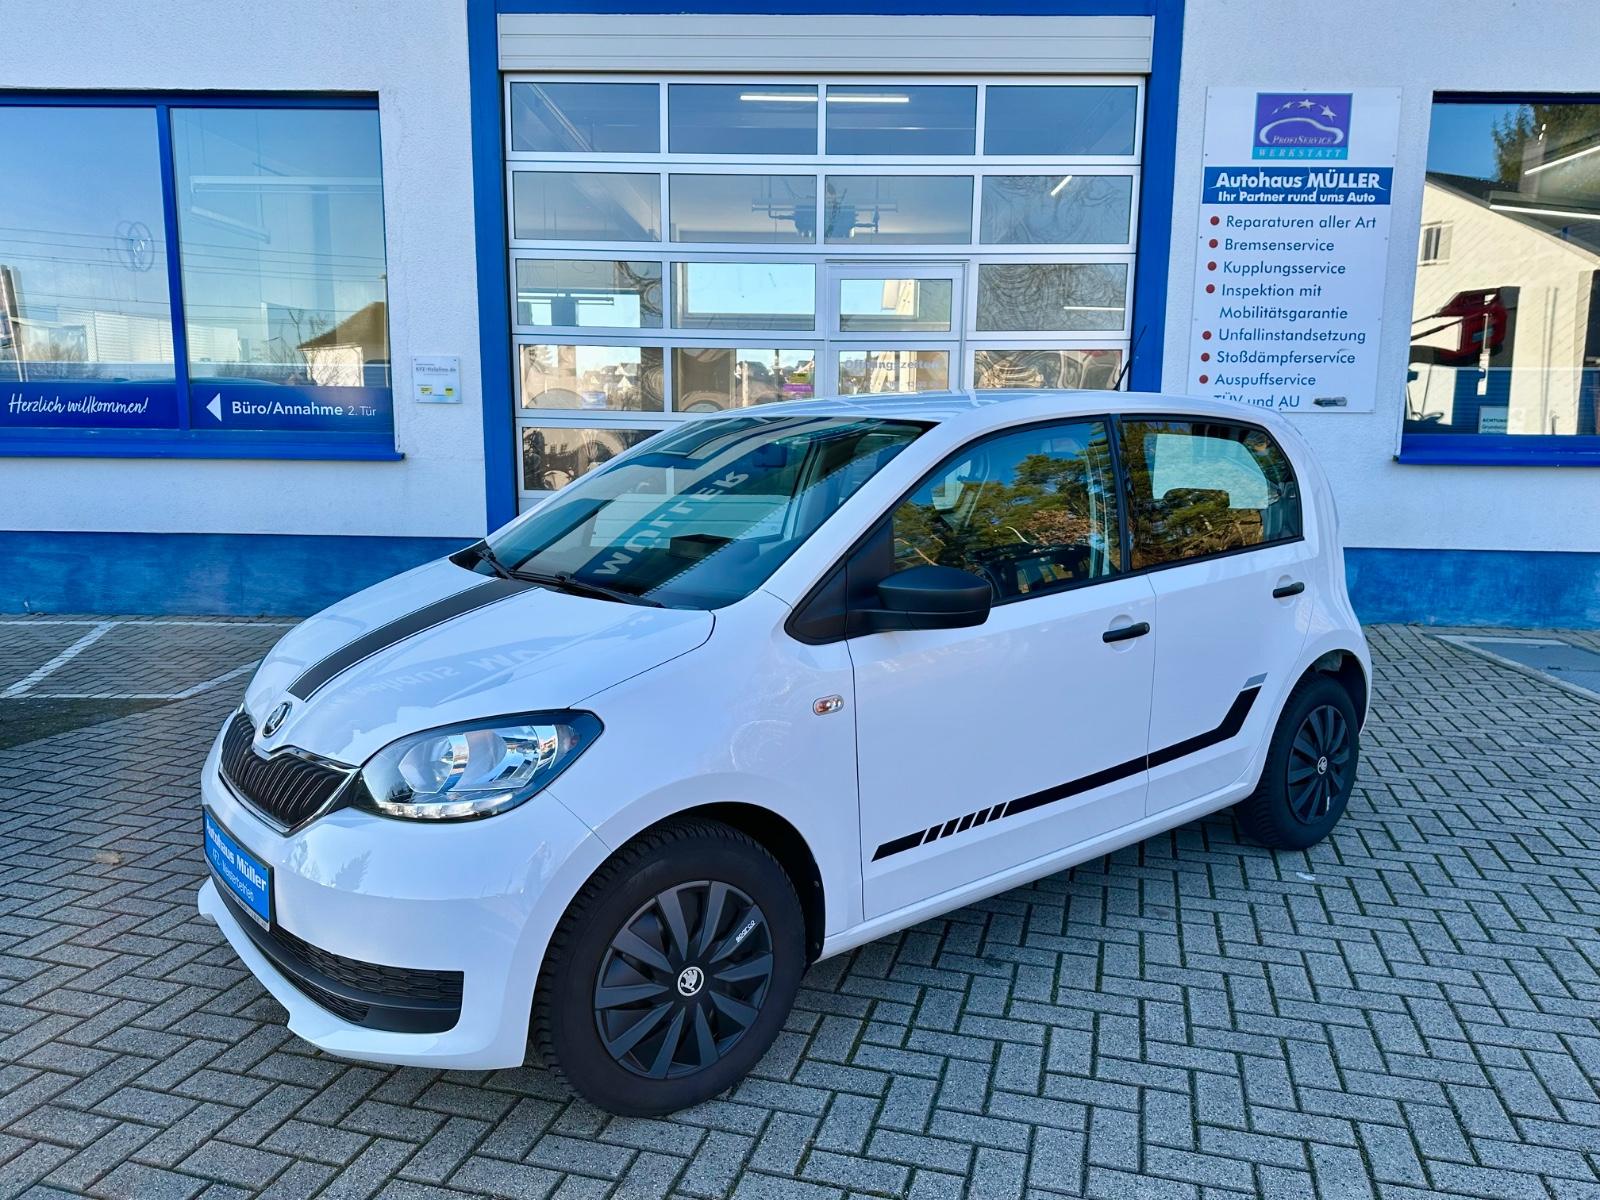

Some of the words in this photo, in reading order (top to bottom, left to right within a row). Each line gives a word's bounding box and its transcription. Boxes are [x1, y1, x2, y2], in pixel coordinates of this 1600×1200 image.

[1258, 149, 1343, 158] WERKSTATT
[1216, 172, 1303, 188] Autohaus
[1307, 169, 1380, 189] MÜLLER
[1218, 191, 1237, 202] Ihr
[1239, 191, 1285, 203] Partner
[1287, 190, 1317, 203] rund
[1319, 194, 1345, 203] ums
[1346, 191, 1376, 203] Auto
[1226, 216, 1314, 230] Reparaturen
[1318, 216, 1351, 228] aller
[1354, 216, 1377, 228] Art
[1225, 239, 1335, 251] Bremsenservice
[1223, 261, 1346, 276] Kupplungsservice
[1221, 284, 1295, 299] Inspektion
[1299, 284, 1322, 297] mit
[1219, 306, 1348, 322] Mobilitätsgarantie
[1218, 328, 1366, 344] Unfallinstandsetzung
[1216, 350, 1356, 366] Stoßdämpferservice
[1214, 373, 1316, 389] Auspuffservice
[8, 393, 66, 414] Herzlich
[67, 396, 149, 414] willkommen!
[231, 400, 343, 416] Büro/Annahme
[347, 405, 358, 416] 2.
[360, 405, 377, 417] Tür
[1278, 395, 1300, 407] AU
[206, 818, 236, 865] Autohaus
[236, 854, 267, 892] Müller
